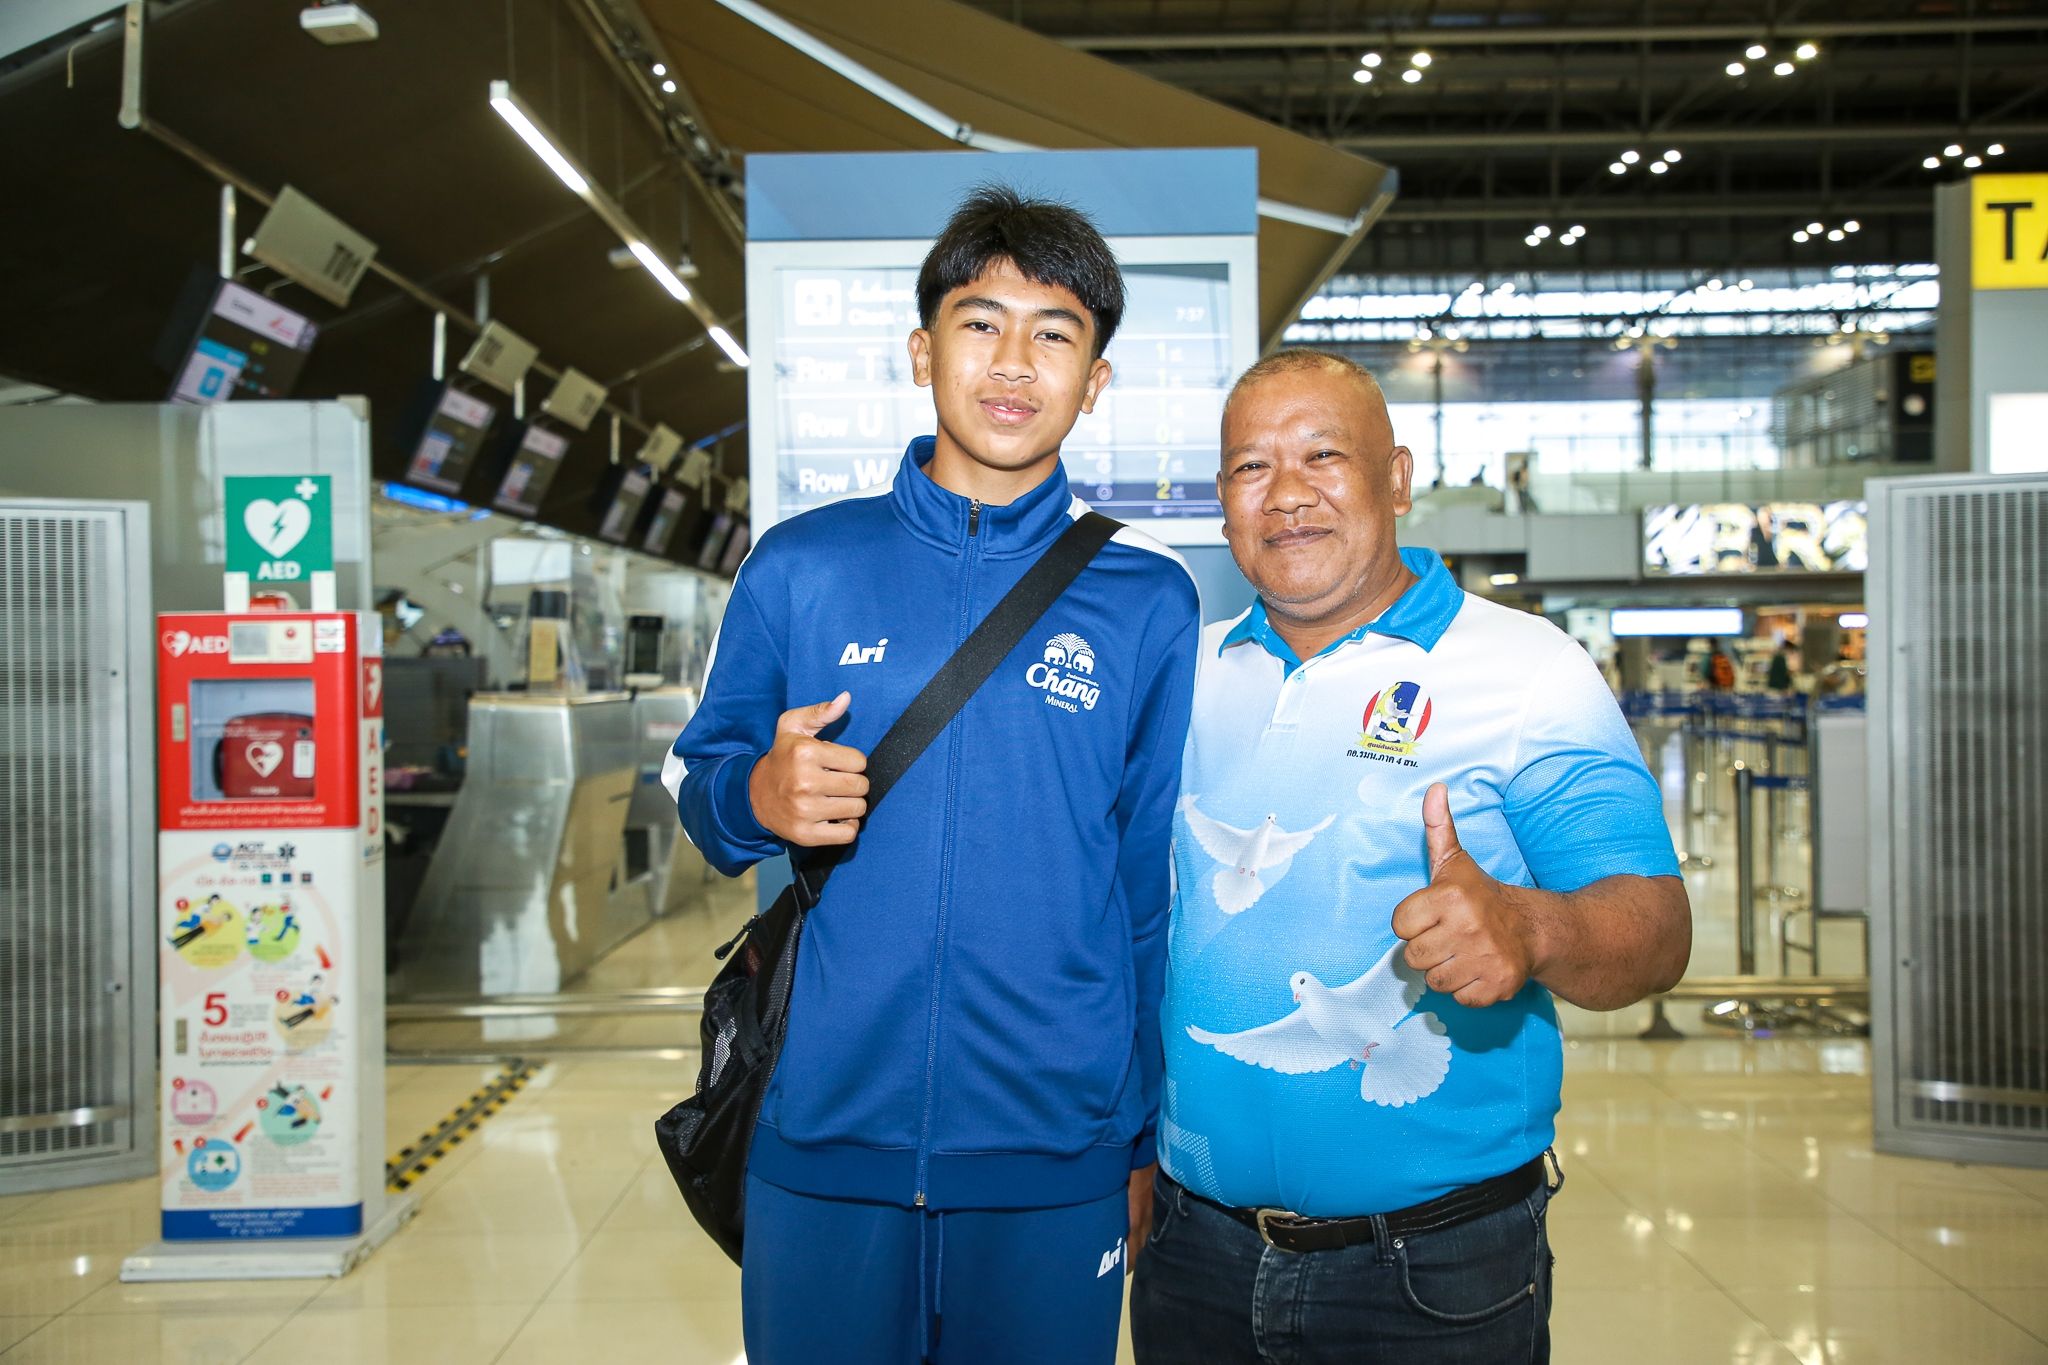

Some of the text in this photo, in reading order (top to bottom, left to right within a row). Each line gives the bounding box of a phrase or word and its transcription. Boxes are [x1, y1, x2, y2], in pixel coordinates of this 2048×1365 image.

[1985, 202, 2048, 261] T
[797, 347, 883, 381] Row T
[797, 402, 883, 437] Row U
[799, 458, 889, 493] Row W
[1156, 452, 1170, 473] 7
[1156, 477, 1171, 500] 2
[257, 561, 301, 580] AED
[189, 636, 230, 654] AED
[838, 637, 889, 666] Ari
[1025, 662, 1101, 711] Chang
[1044, 694, 1079, 714] MINERAL
[1396, 757, 1403, 765] 4
[203, 993, 229, 1027] 5
[1097, 1237, 1123, 1279] Ari
